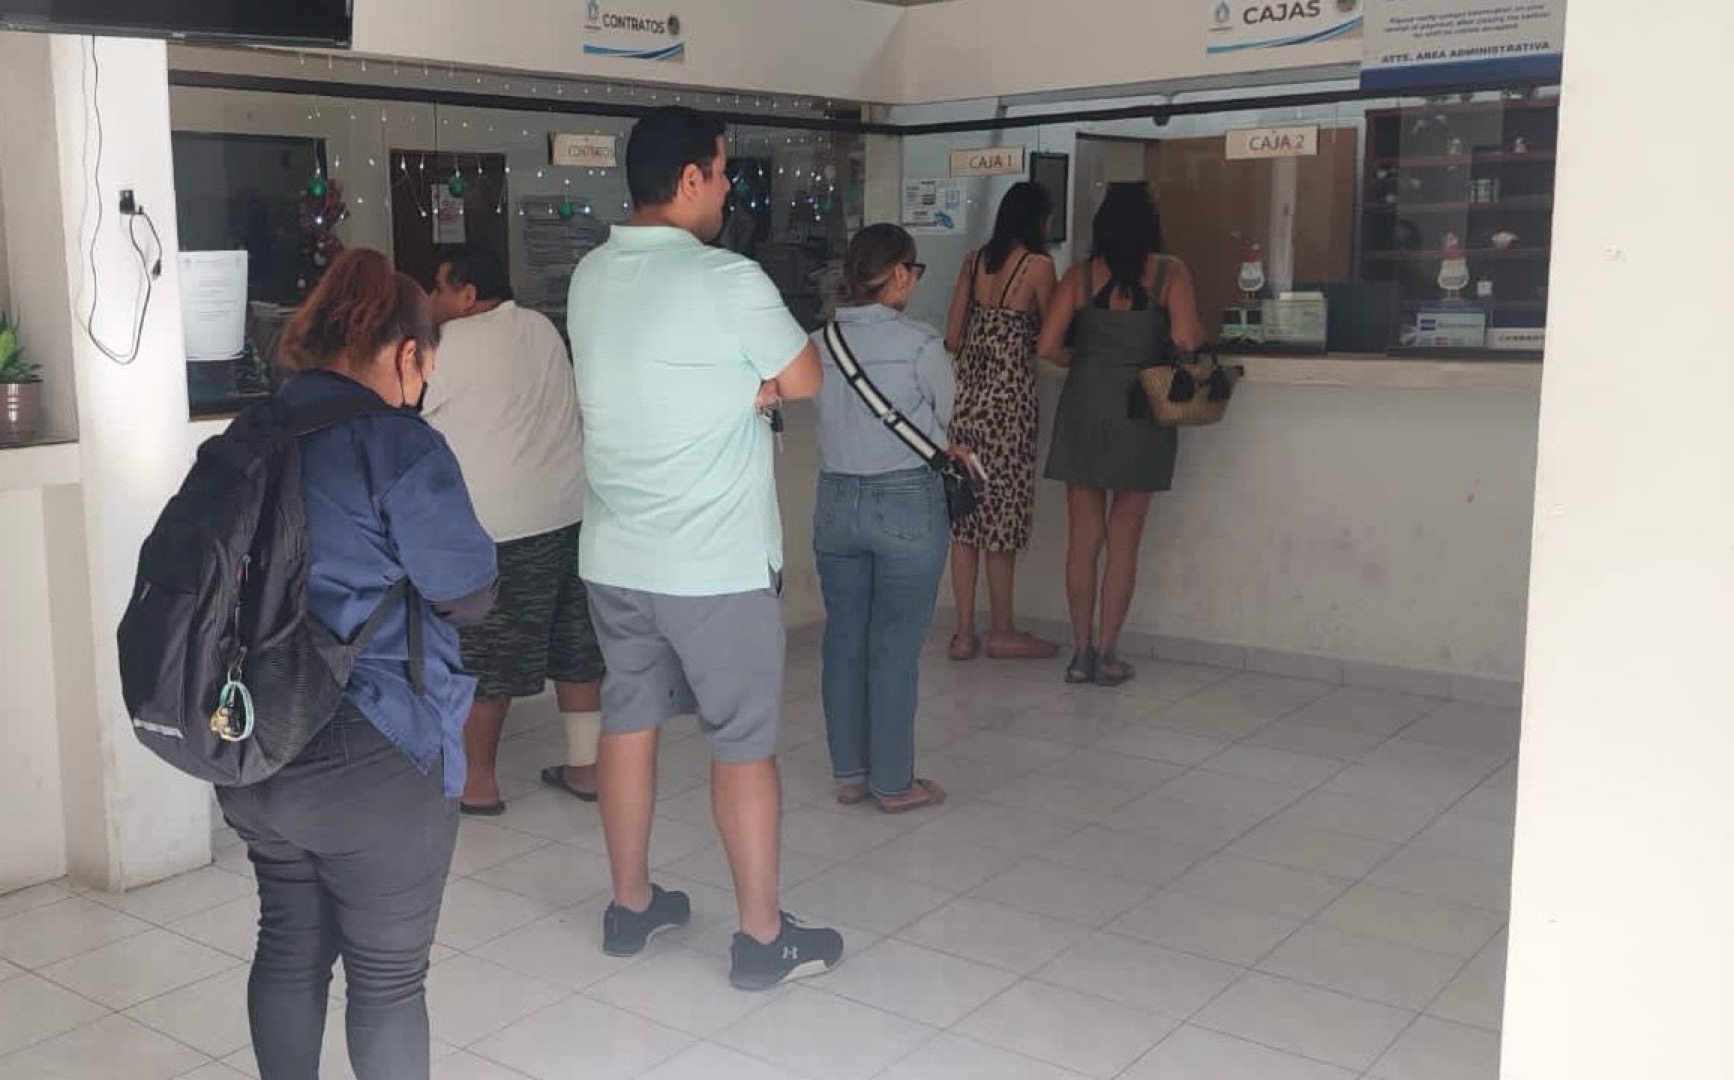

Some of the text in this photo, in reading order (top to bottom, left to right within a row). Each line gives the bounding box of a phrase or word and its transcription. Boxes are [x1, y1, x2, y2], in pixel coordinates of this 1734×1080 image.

[1243, 0, 1321, 24] CAJAS
[602, 13, 665, 34] CONTRATOS
[1450, 41, 1549, 58] ADMINISTRATIVA
[1248, 133, 1305, 151] CAJA 2
[968, 154, 1003, 169] CAJA
